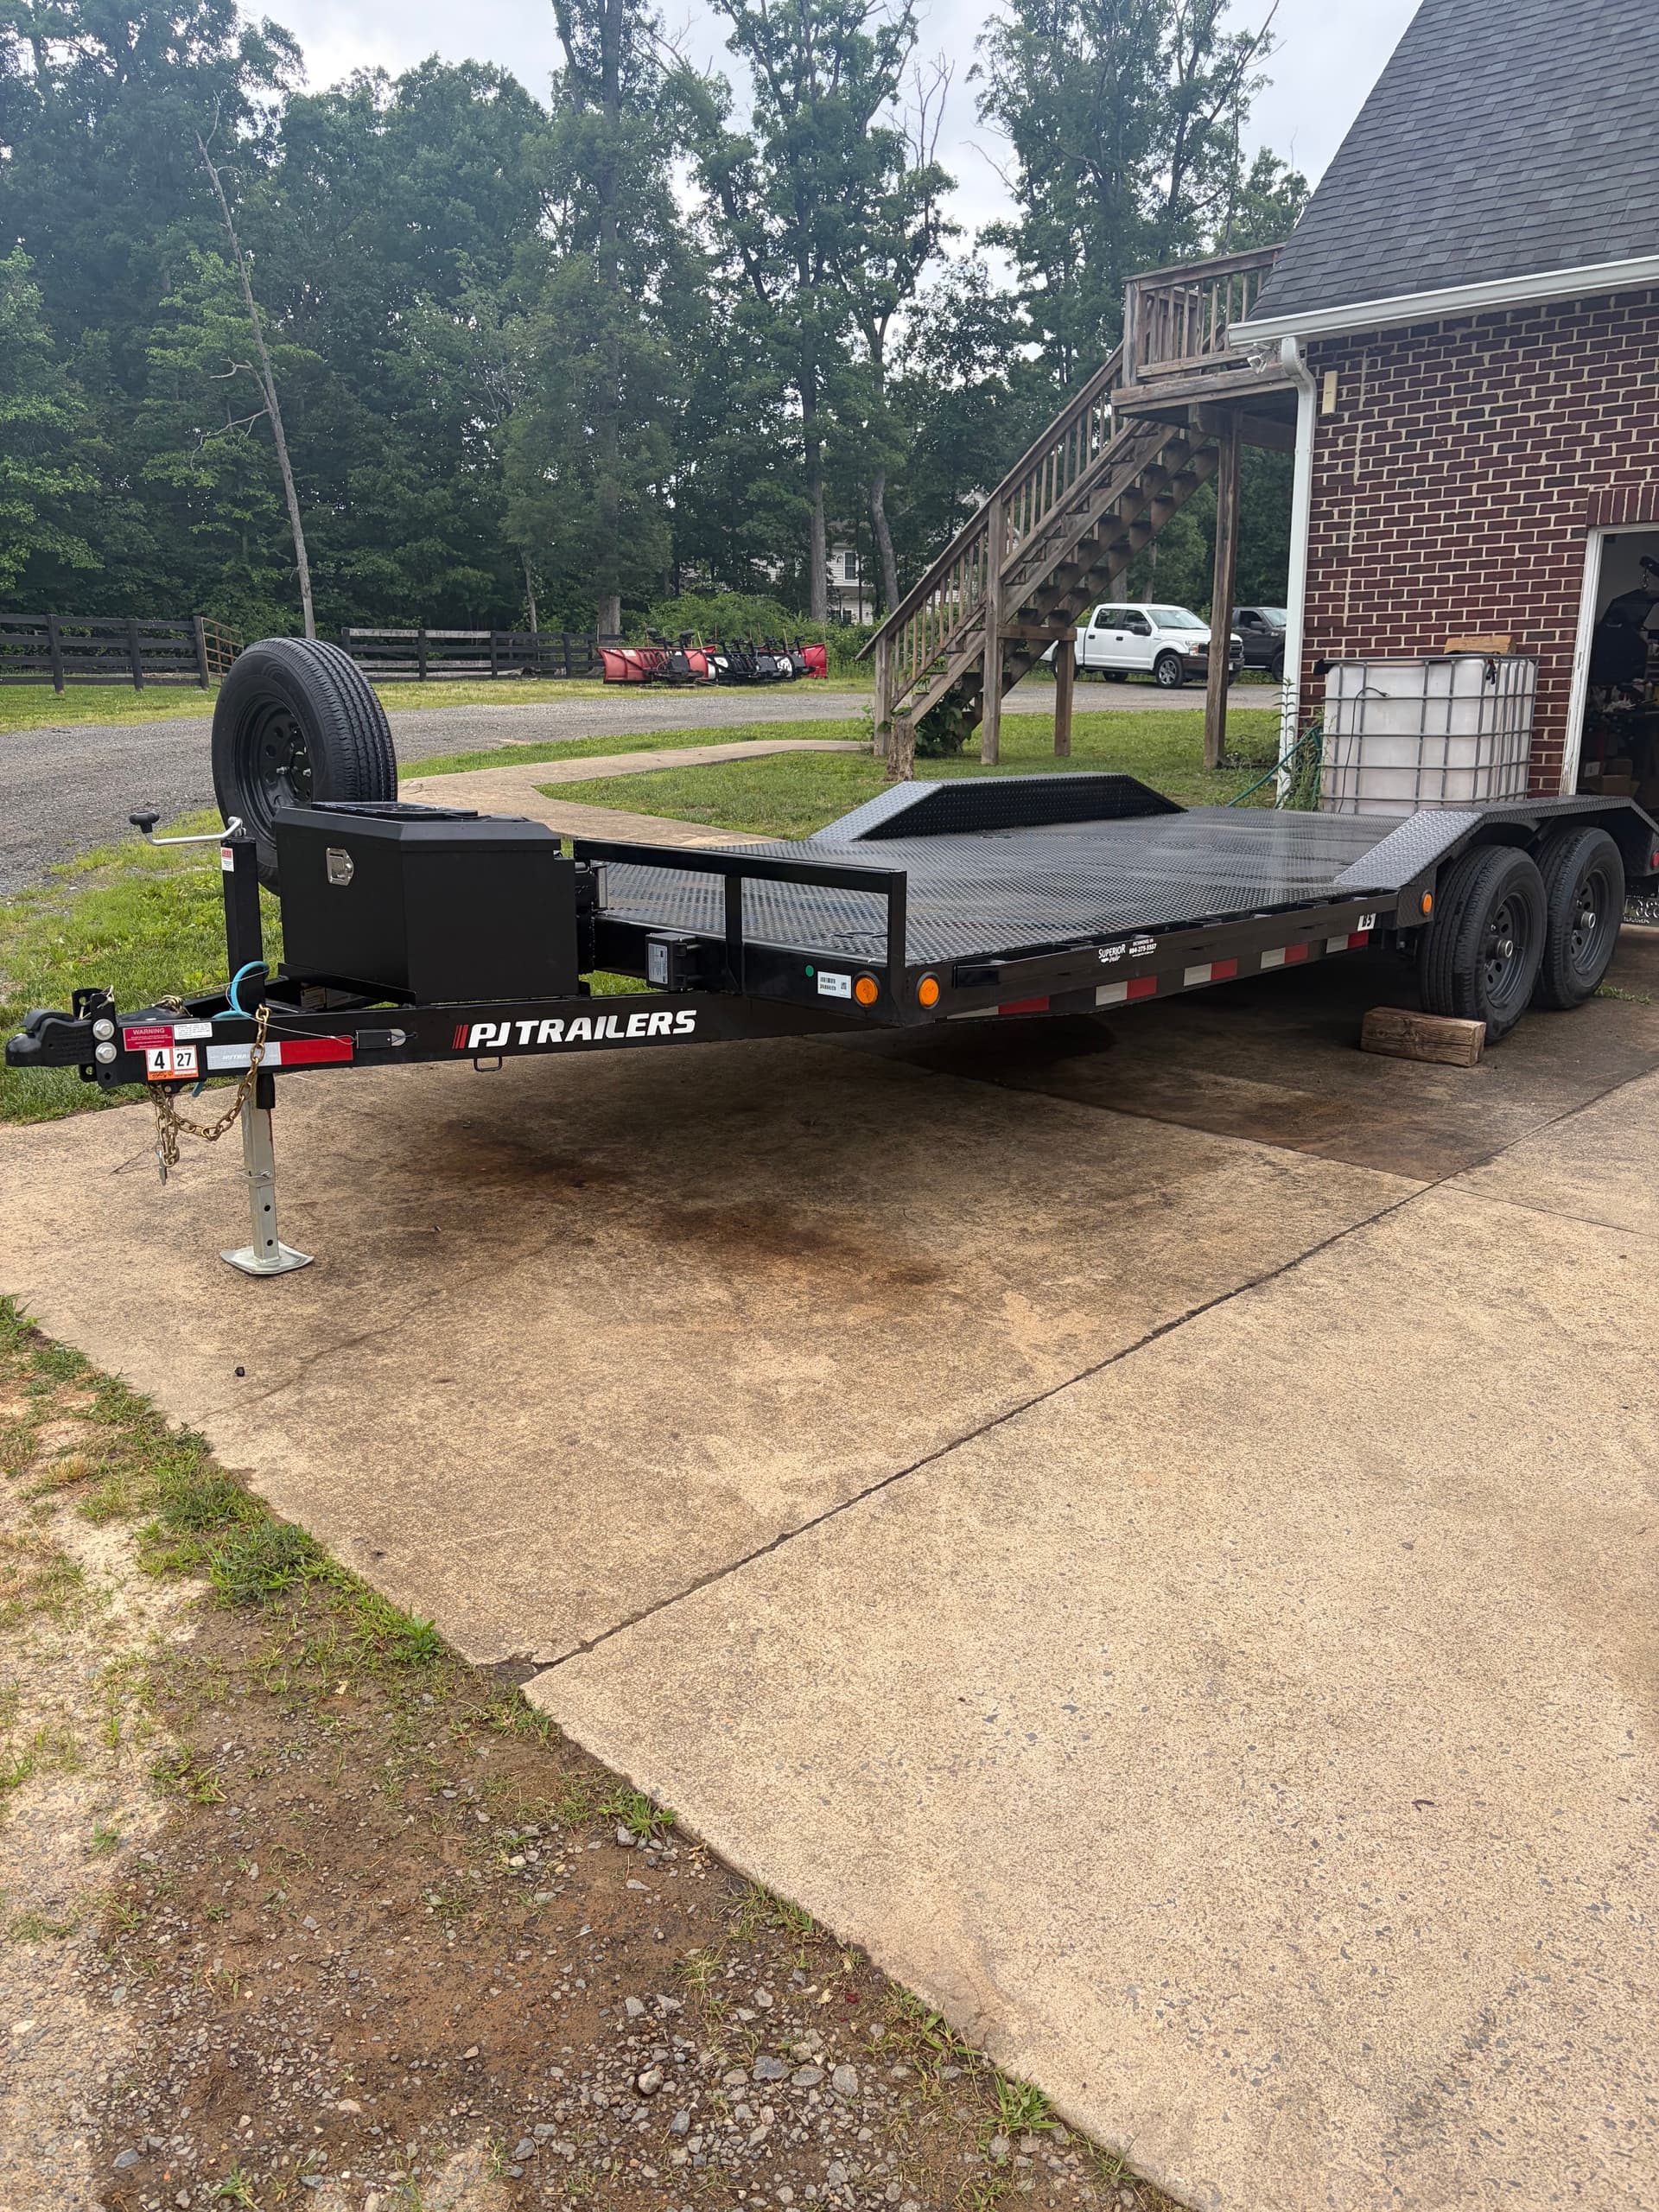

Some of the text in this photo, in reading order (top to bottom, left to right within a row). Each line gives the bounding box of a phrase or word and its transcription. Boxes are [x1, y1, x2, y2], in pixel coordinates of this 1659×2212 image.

[1098, 944, 1126, 959] SUPERIOR
[467, 1009, 697, 1049] PJ TRAILERS
[154, 1051, 165, 1070] 4
[176, 1052, 192, 1067] 27
